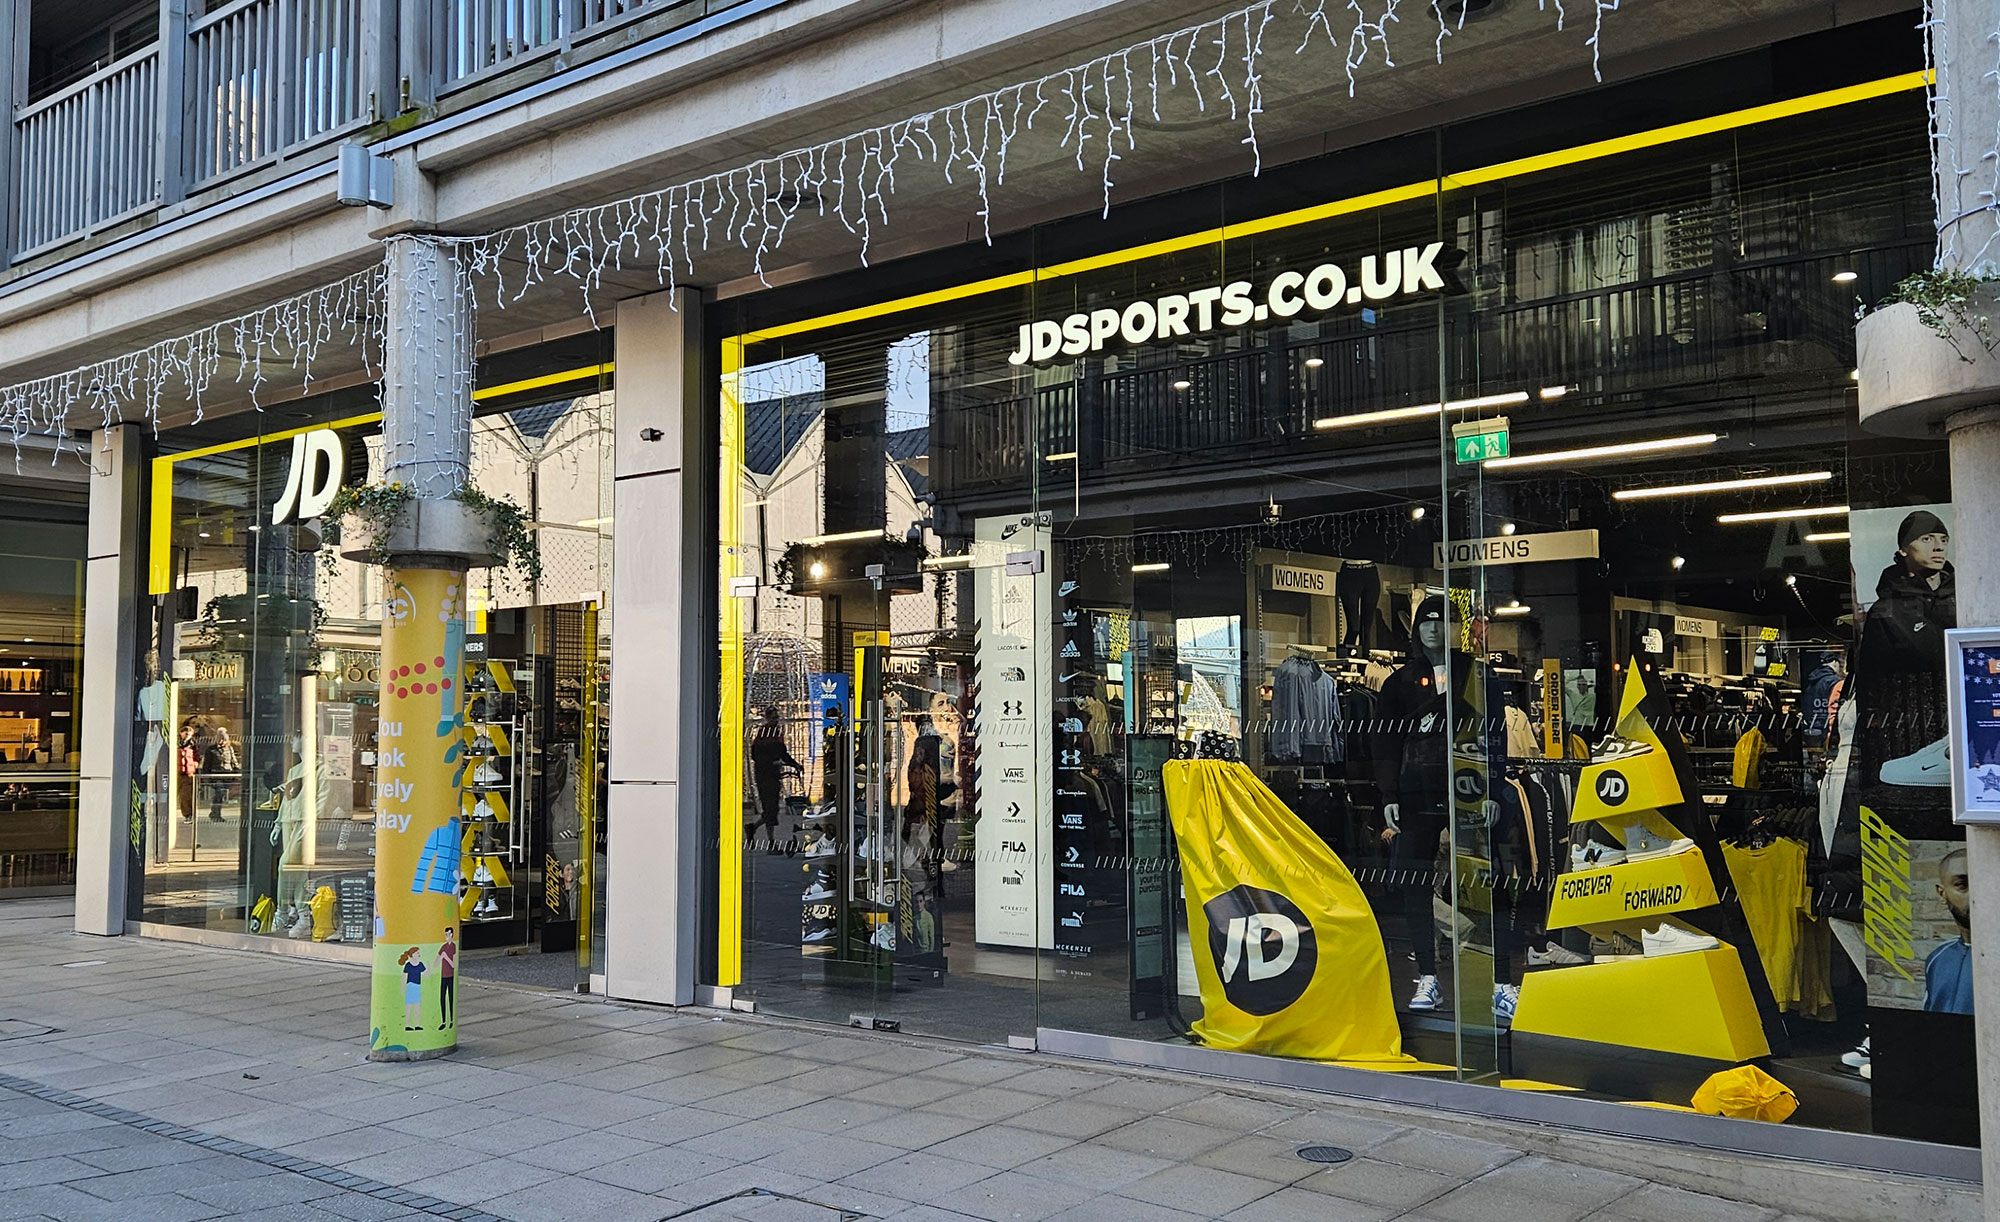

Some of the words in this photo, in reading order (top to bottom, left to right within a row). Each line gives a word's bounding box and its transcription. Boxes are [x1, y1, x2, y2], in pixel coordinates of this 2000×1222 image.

[1007, 241, 1445, 366] JDSPORTS.CO.UK
[272, 428, 344, 526] JD
[1438, 540, 1530, 564] WOMENS
[1275, 569, 1324, 591] WOMENS
[1676, 619, 1703, 634] WOMENS
[881, 656, 920, 674] MENS
[1060, 650, 1081, 658] adidas
[1551, 672, 1560, 711] ORDER
[1552, 713, 1562, 745] HERE
[1003, 768, 1025, 778] VANS
[1600, 777, 1625, 798] JD
[1062, 814, 1083, 825] VANS
[1002, 841, 1026, 853] FILA
[546, 853, 560, 915] FOREVER
[1060, 884, 1085, 896] FILA
[1561, 874, 1613, 900] FOREVER
[1859, 805, 1915, 983] FOREVER
[1625, 885, 1683, 911] FORWARD
[1221, 913, 1300, 983] JD
